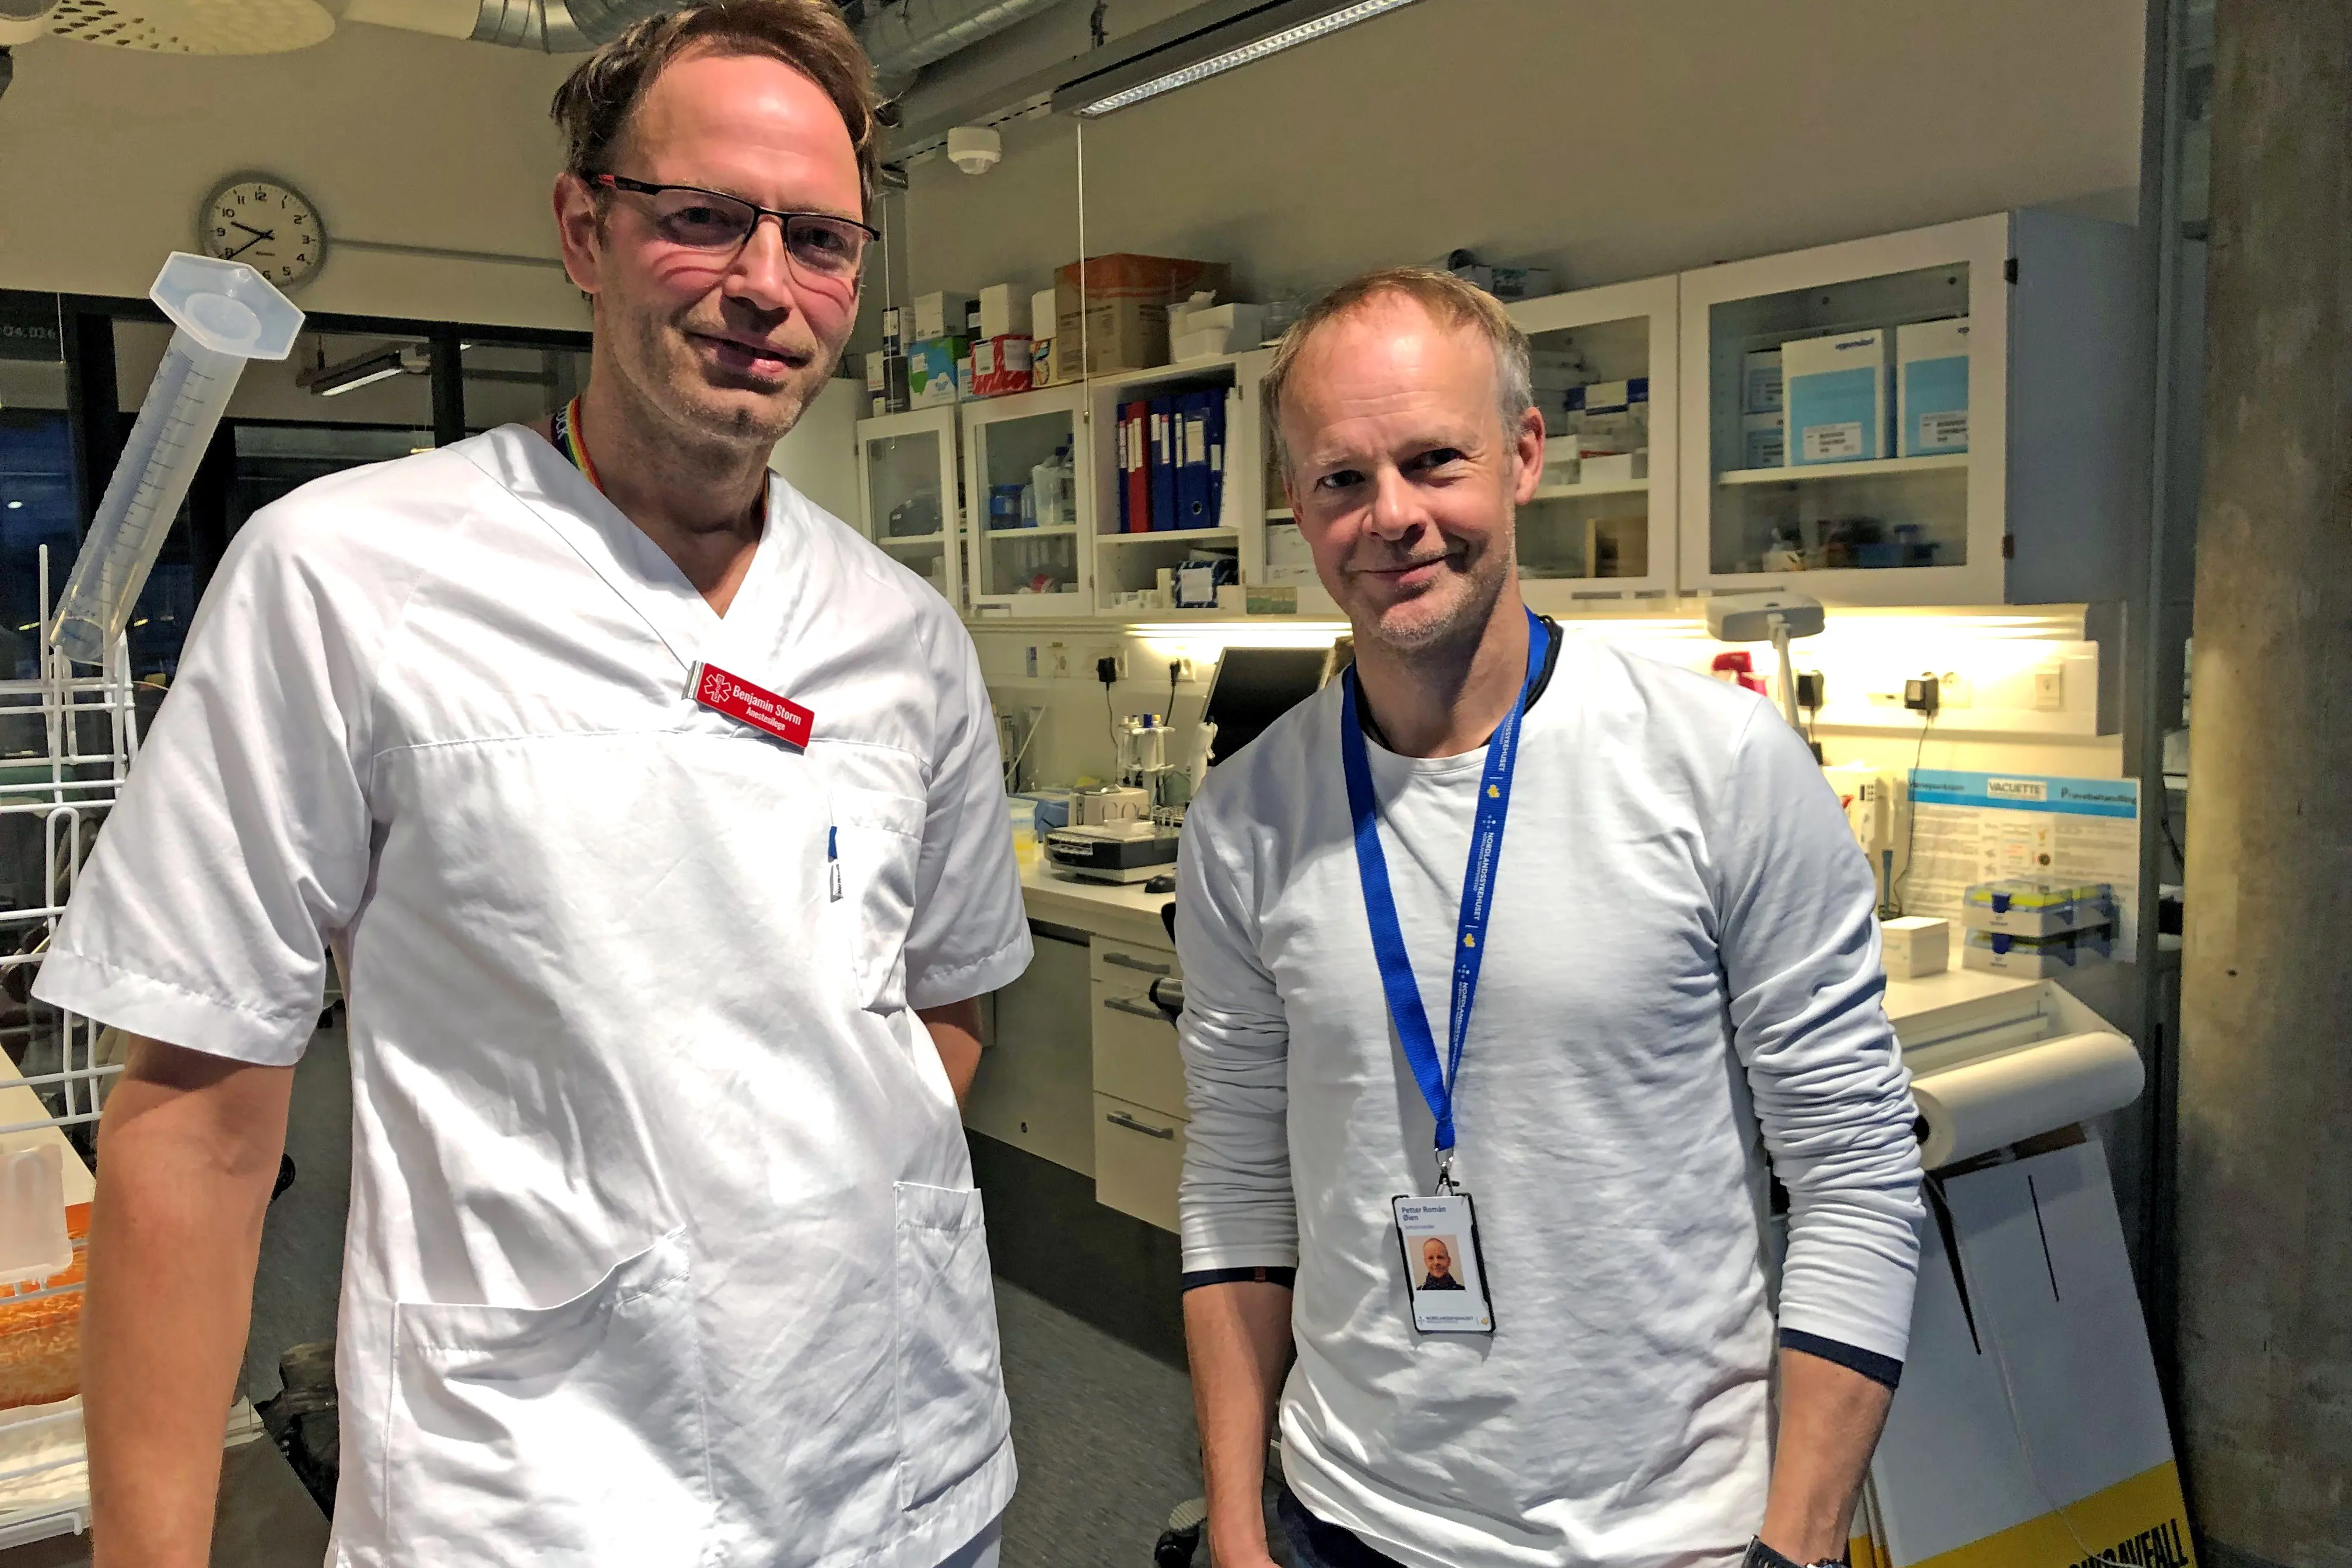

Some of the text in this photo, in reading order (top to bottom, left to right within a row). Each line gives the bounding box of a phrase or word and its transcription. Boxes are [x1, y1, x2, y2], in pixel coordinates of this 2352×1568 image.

[237, 195, 245, 205] 11
[254, 191, 267, 201] 12
[281, 200, 285, 209] 1
[222, 208, 235, 218] 10
[293, 214, 302, 225] 2
[216, 228, 226, 237] 9
[302, 235, 310, 244] 3
[296, 253, 306, 262] 4
[262, 270, 271, 280] 6
[282, 265, 291, 276] 5
[733, 684, 802, 726] Benjamin Storm
[746, 706, 786, 731] Anestesilege
[1989, 782, 2041, 794] VACUETTE
[1474, 832, 1494, 921] NORDLANDSSYKEHUSET
